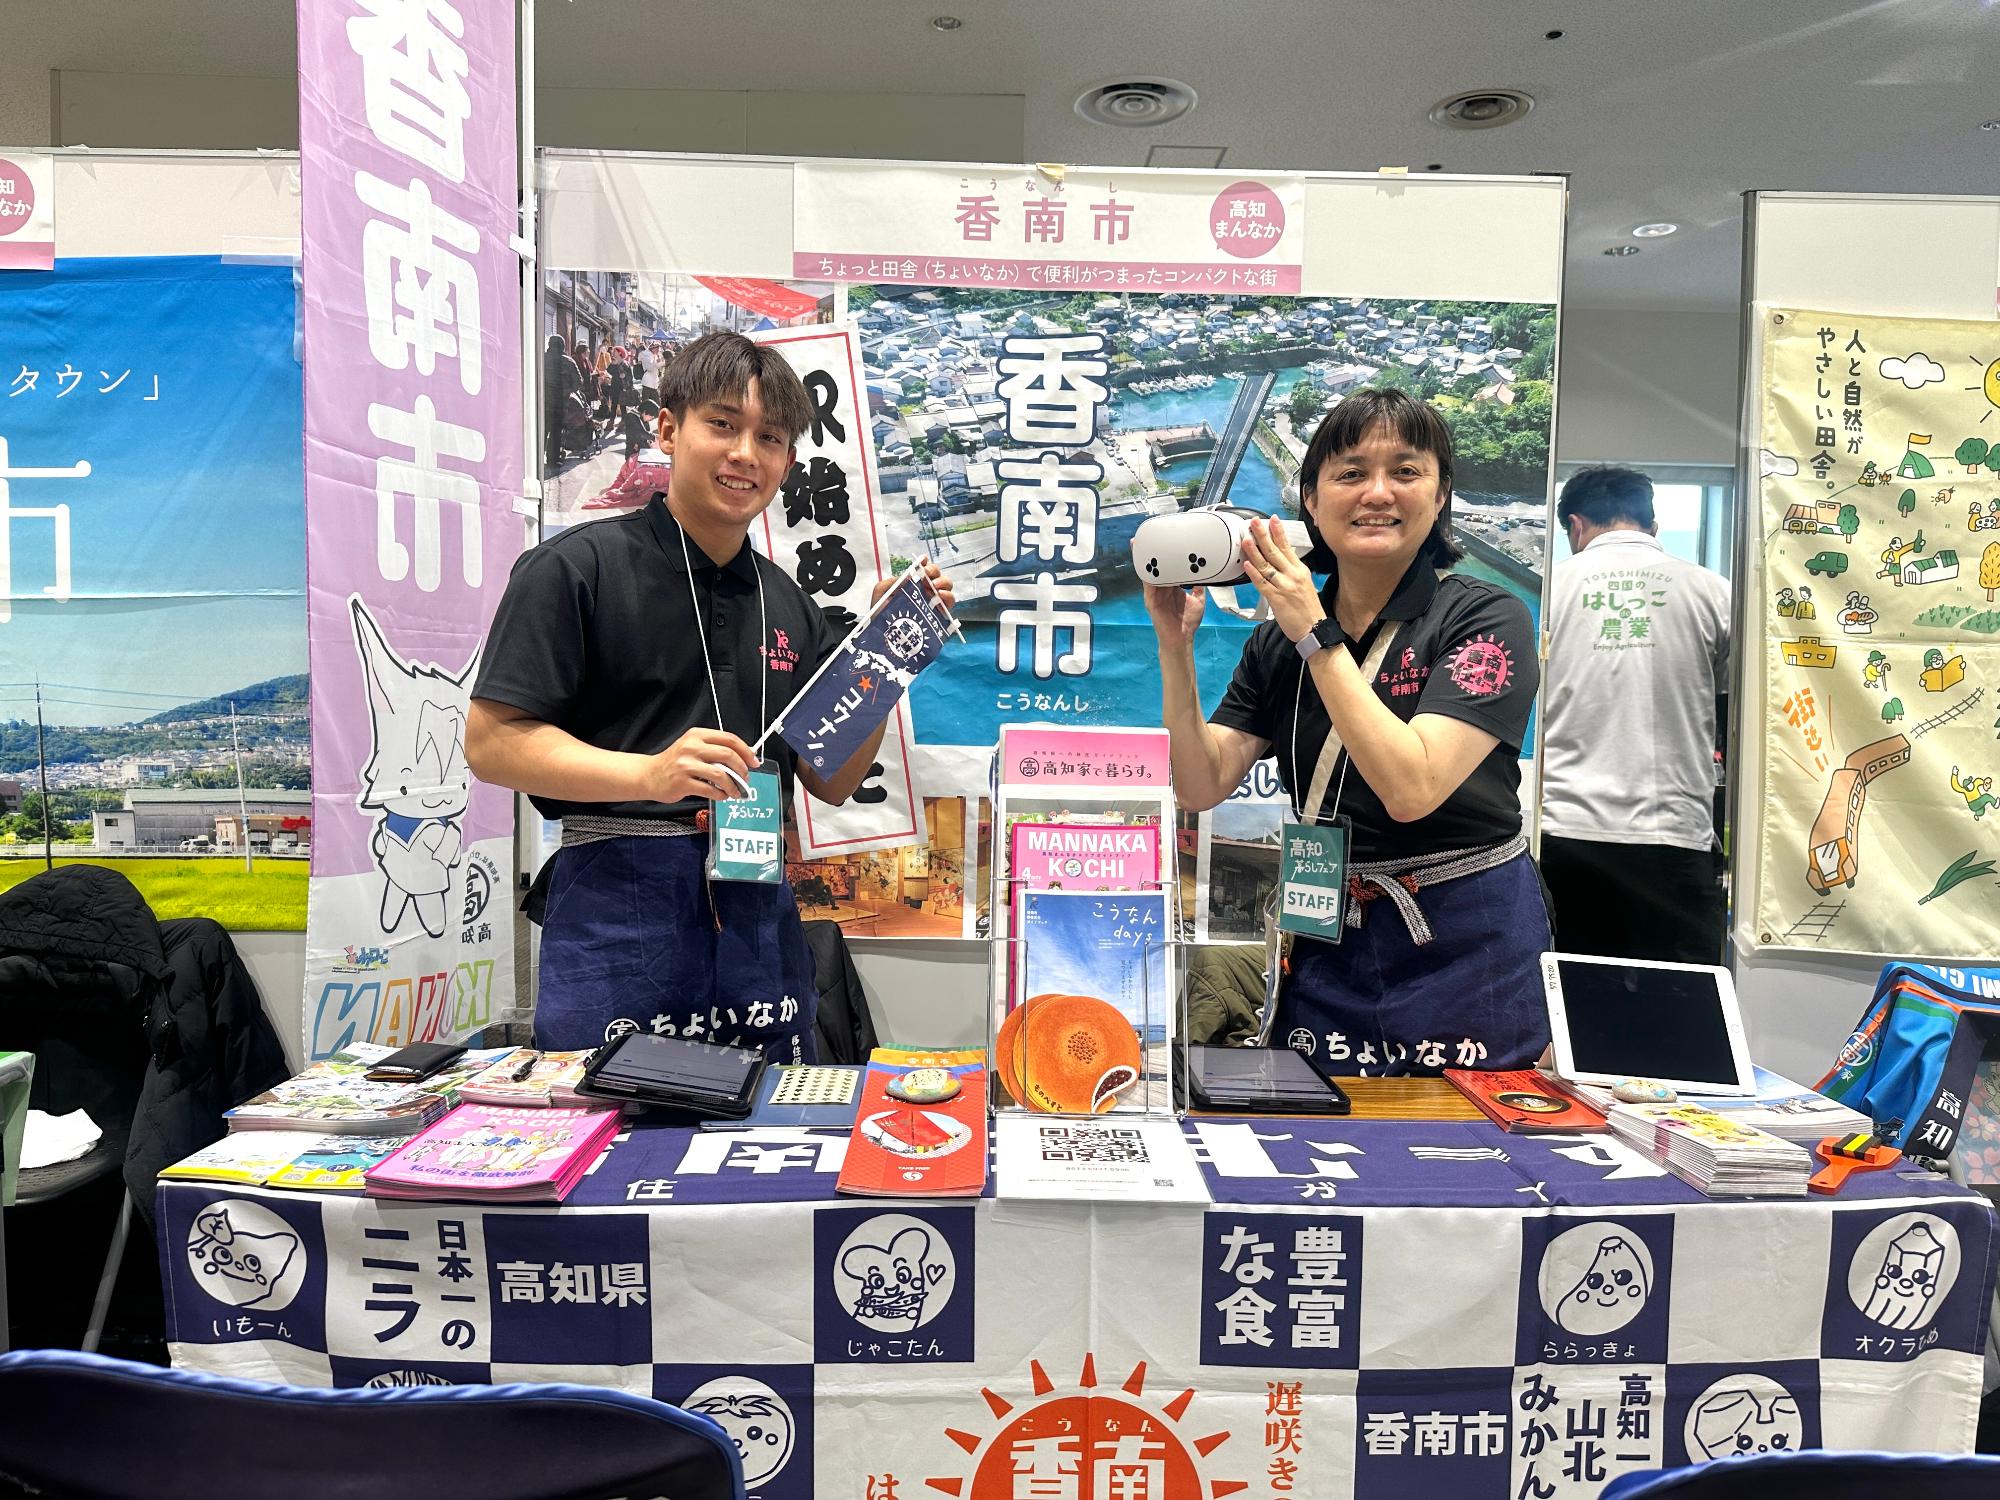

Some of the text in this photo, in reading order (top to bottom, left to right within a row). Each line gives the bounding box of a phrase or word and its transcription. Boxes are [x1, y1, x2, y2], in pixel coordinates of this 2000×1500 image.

[954, 196, 1134, 244] 香南市
[1229, 200, 1266, 219] 高知
[1215, 219, 1281, 240] まんなか
[1842, 329, 1866, 455] 人と自然が
[1810, 327, 1836, 489] やさしい田舎。
[994, 334, 1111, 681] 香南市
[1583, 570, 1673, 585] TOSASHIMIZU
[1608, 580, 1646, 591] 四国の
[1582, 591, 1668, 611] はしっこ
[1600, 617, 1652, 641] 農業
[1593, 642, 1656, 652] Enjoy Agriculture
[1380, 665, 1430, 684] ちょいなか
[1390, 682, 1420, 697] 香南市
[996, 693, 1090, 713] こうなんし
[1782, 687, 1830, 772] 街近い
[724, 837, 774, 856] STAFF
[1028, 831, 1147, 853] MANNAKA
[1290, 838, 1322, 858] 高知
[1287, 890, 1335, 912] STAFF
[1093, 902, 1157, 926] こうなん
[1113, 926, 1153, 948] days
[650, 996, 799, 1036] ちょいなか
[1325, 1032, 1488, 1067] ちょいなか
[363, 1227, 422, 1343] ニラ
[438, 1220, 477, 1351] 日本一の
[497, 1262, 648, 1308] 高知県
[1218, 1226, 1276, 1348] な食
[1288, 1226, 1348, 1350] 豊富
[213, 1315, 292, 1339] いもーん
[847, 1338, 944, 1358] じゃこたん
[1543, 1341, 1637, 1359] ららっきょ
[1855, 1330, 1940, 1354] オクラひめ
[1021, 1418, 1155, 1434] こうなん
[1616, 1373, 1652, 1461] 高知一
[1264, 1381, 1303, 1500] 遅咲き
[1363, 1410, 1507, 1457] 香南市
[1518, 1373, 1560, 1500] みかん
[1562, 1399, 1607, 1482] 山北
